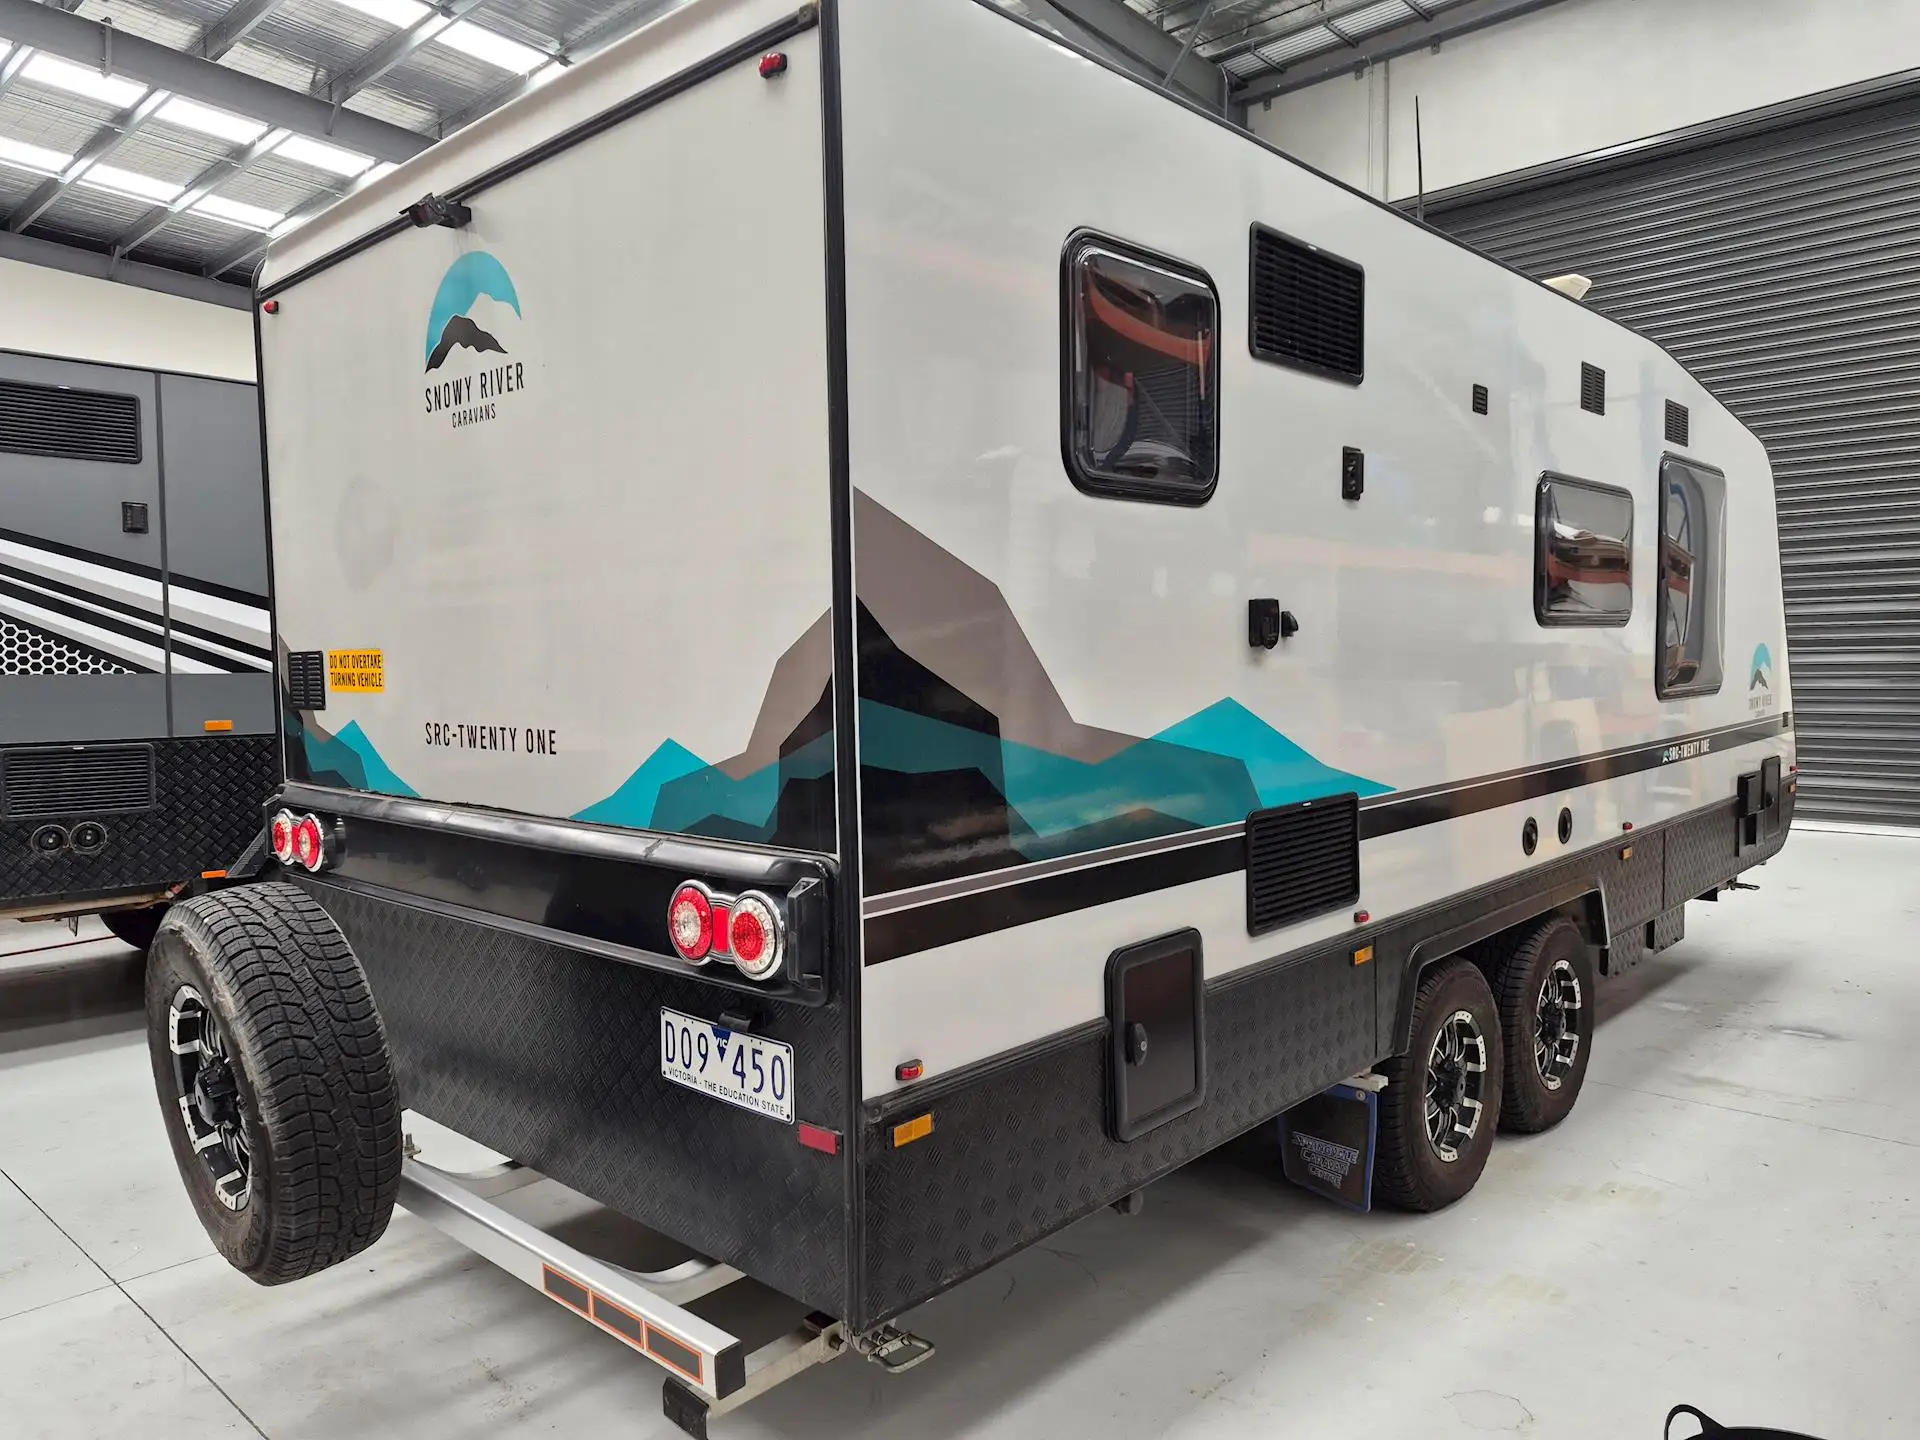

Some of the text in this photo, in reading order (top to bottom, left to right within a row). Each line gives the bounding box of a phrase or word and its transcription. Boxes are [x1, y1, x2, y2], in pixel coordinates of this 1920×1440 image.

[425, 362, 524, 413] SNOWY RIVER
[452, 403, 496, 428] CARAVANS
[329, 654, 382, 669] DO NOT OVERTAKE
[330, 672, 383, 687] TURNING VEHICLE
[425, 722, 557, 755] SRC-TWENTY ONE
[1668, 738, 1710, 761] SRC-TWENTY ONE
[665, 1020, 785, 1101] D09 450
[668, 1067, 697, 1085] VICTORIA
[704, 1080, 717, 1092] THE
[719, 1085, 759, 1107] EDUCATION
[761, 1100, 784, 1116] STATE
